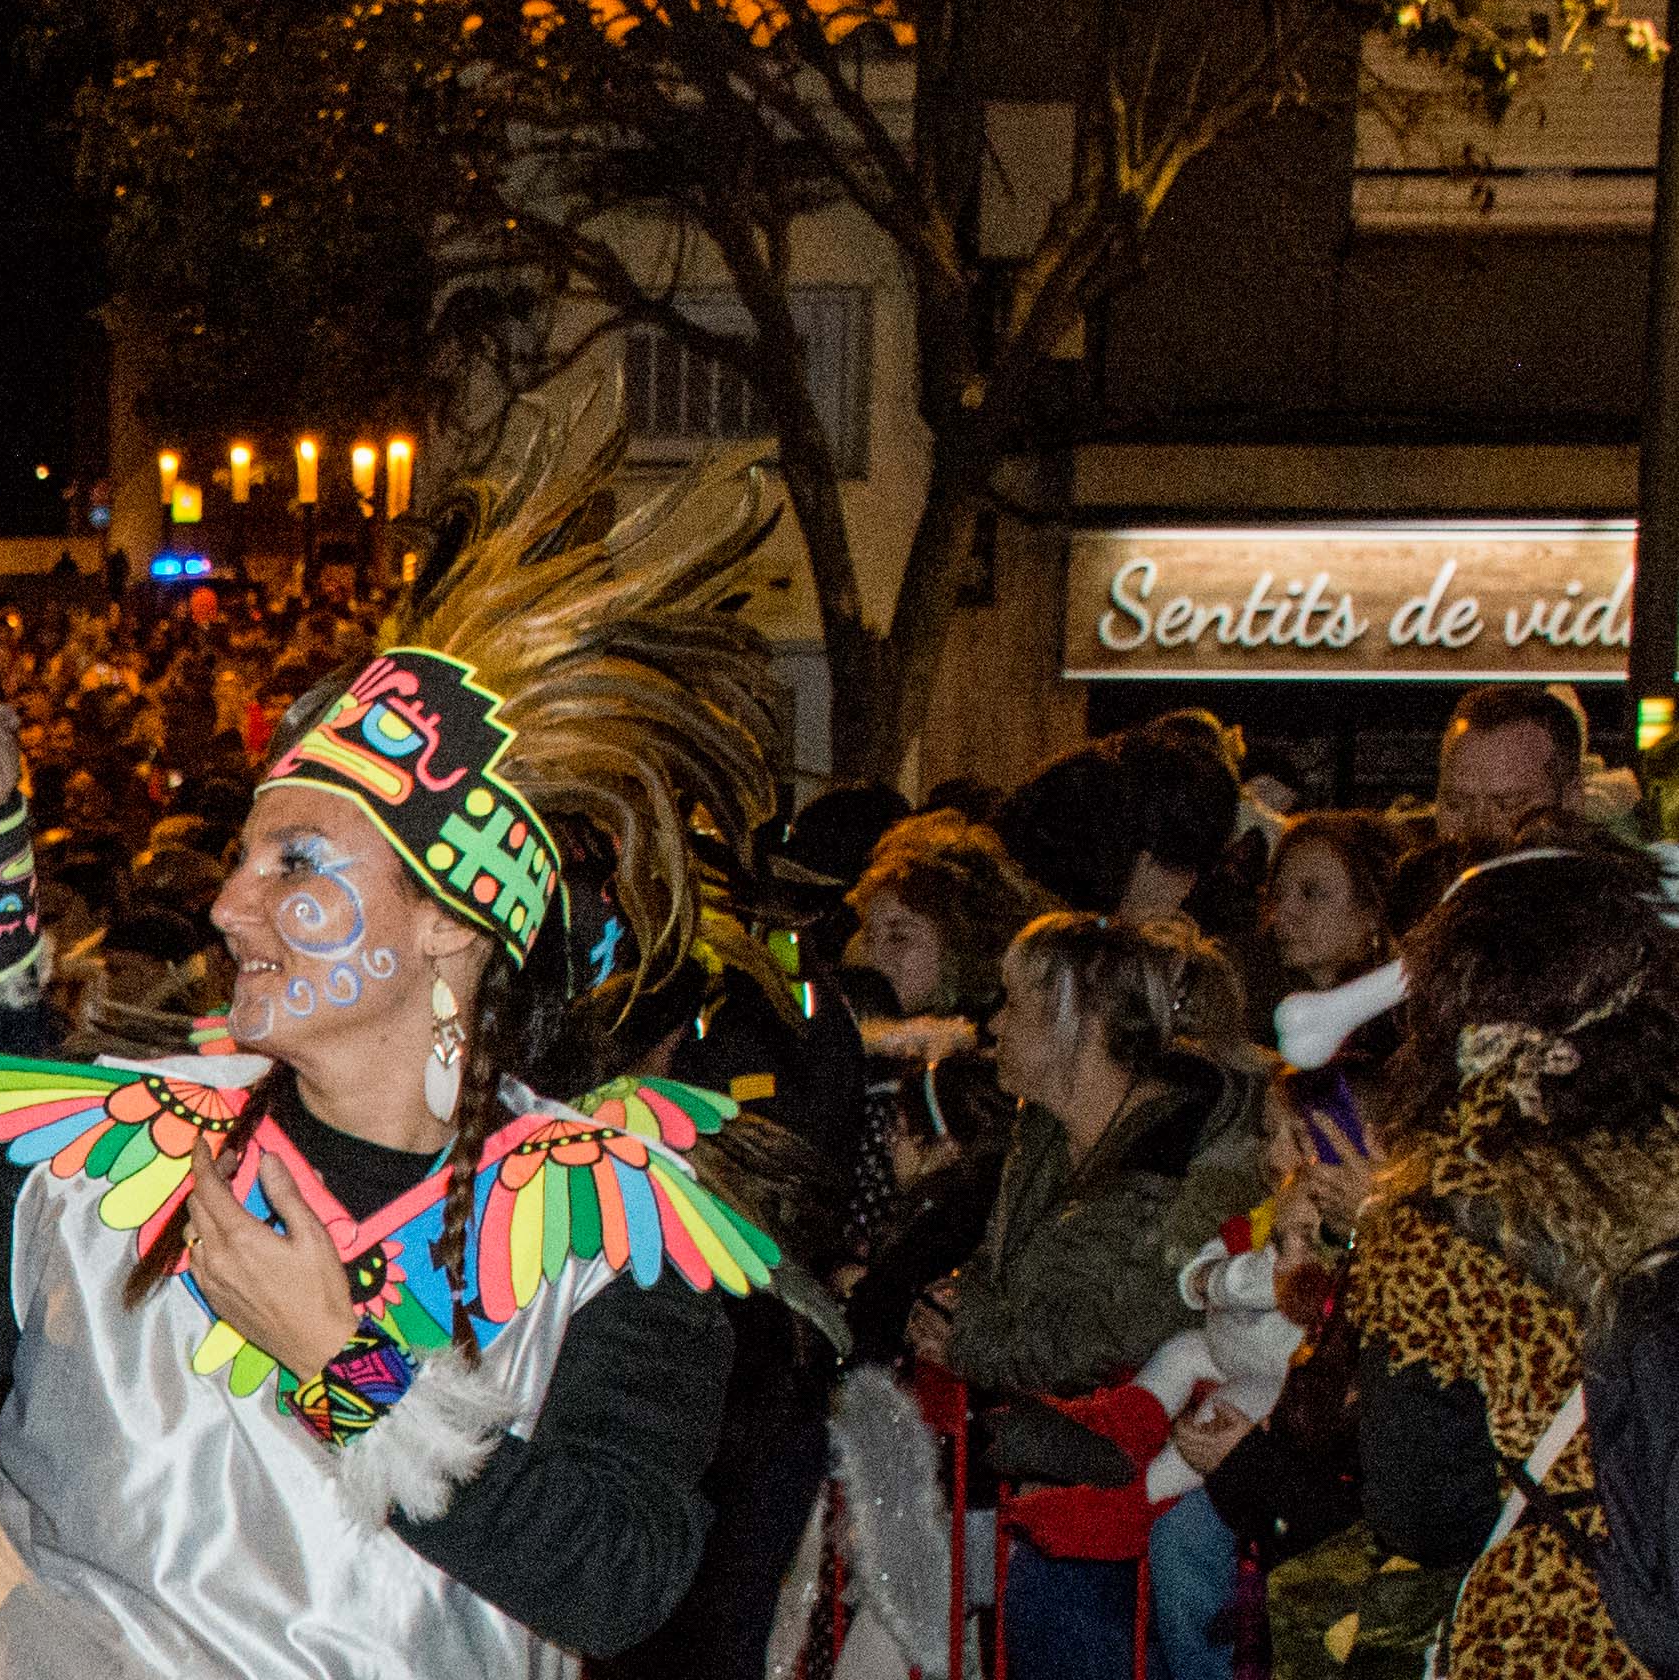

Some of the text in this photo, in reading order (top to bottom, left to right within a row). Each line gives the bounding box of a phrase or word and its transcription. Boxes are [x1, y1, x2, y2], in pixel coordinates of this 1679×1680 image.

[1099, 557, 1632, 651] Sentits de vid
